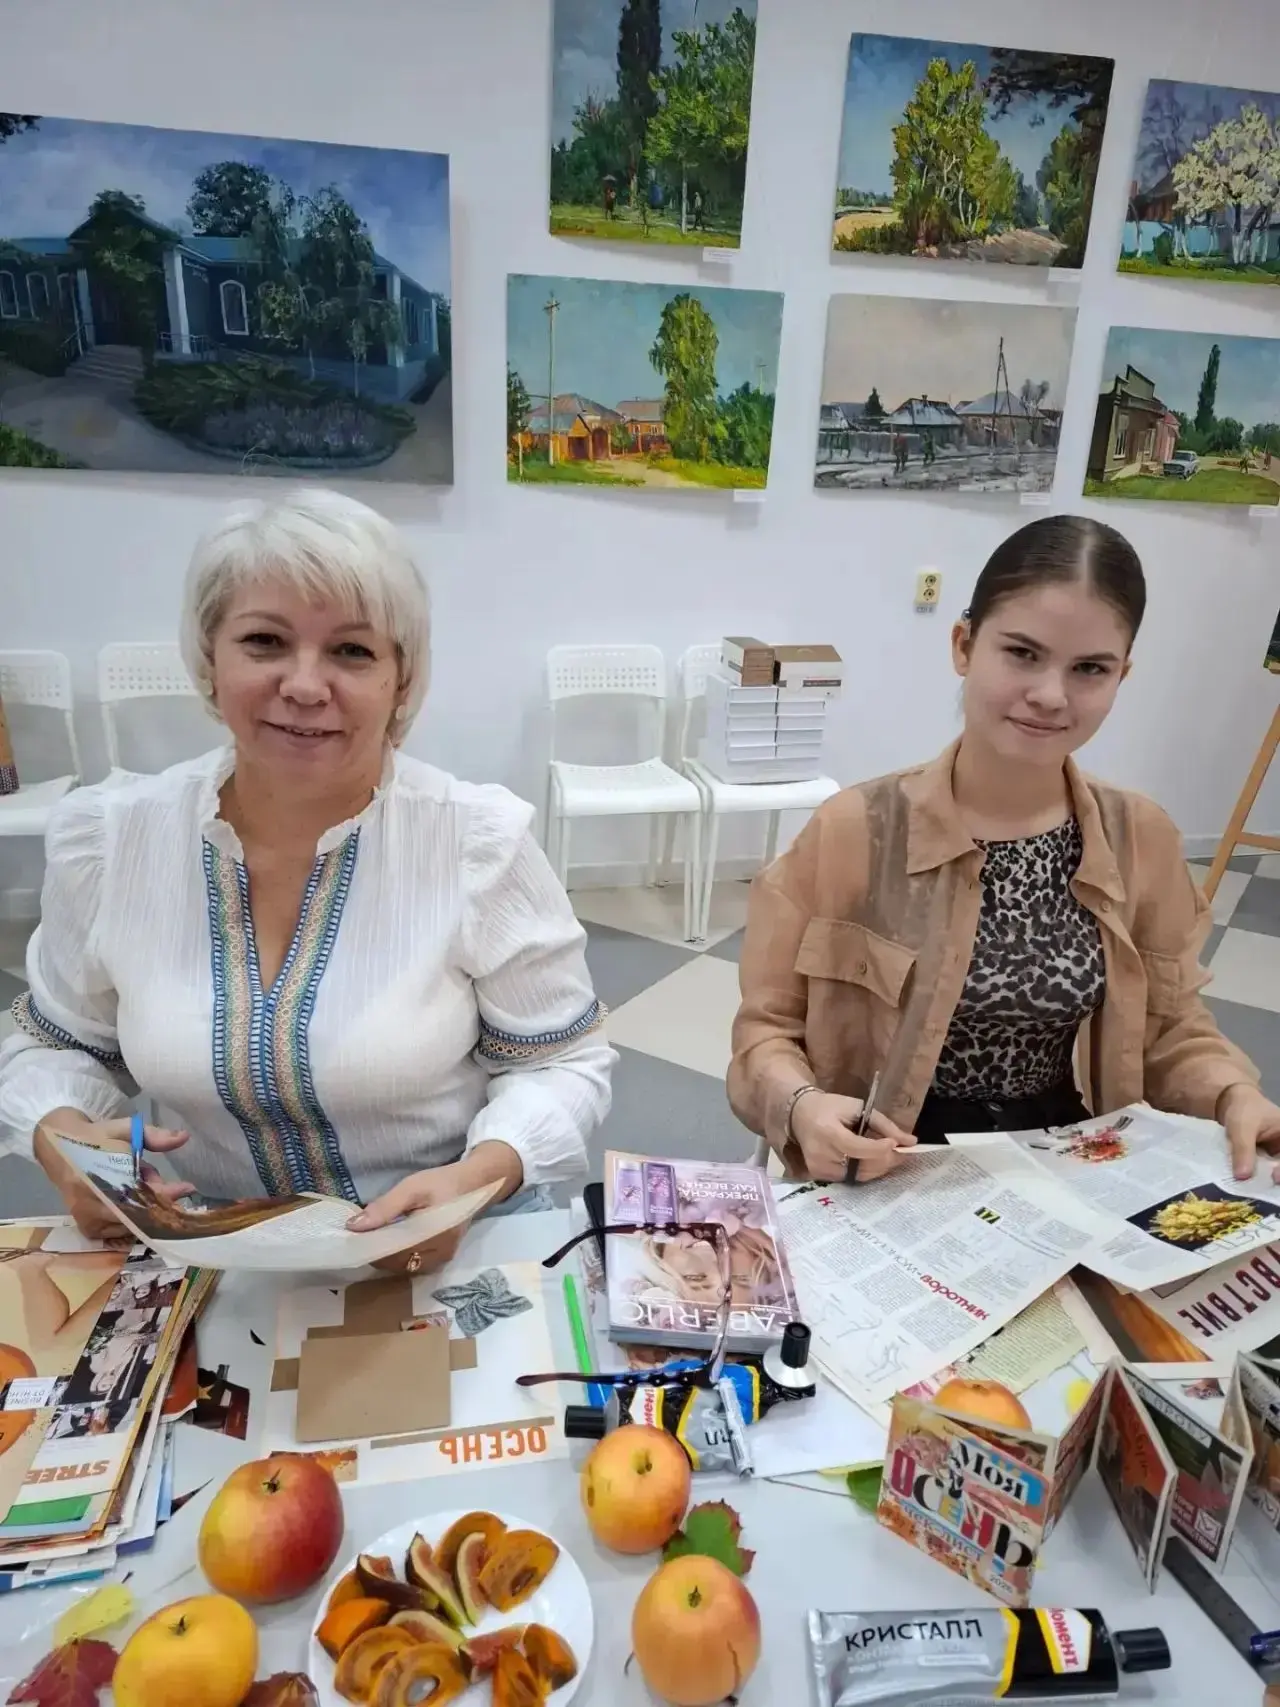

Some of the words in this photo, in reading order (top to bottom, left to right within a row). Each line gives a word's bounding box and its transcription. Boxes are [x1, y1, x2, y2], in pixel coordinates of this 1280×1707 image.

[732, 1183, 757, 1192] КАК
[1177, 1245, 1280, 1337] ВСТВИЕ
[439, 1425, 547, 1465] ОСЕНЬ
[844, 1619, 983, 1652] КРИСТАЛЛ
